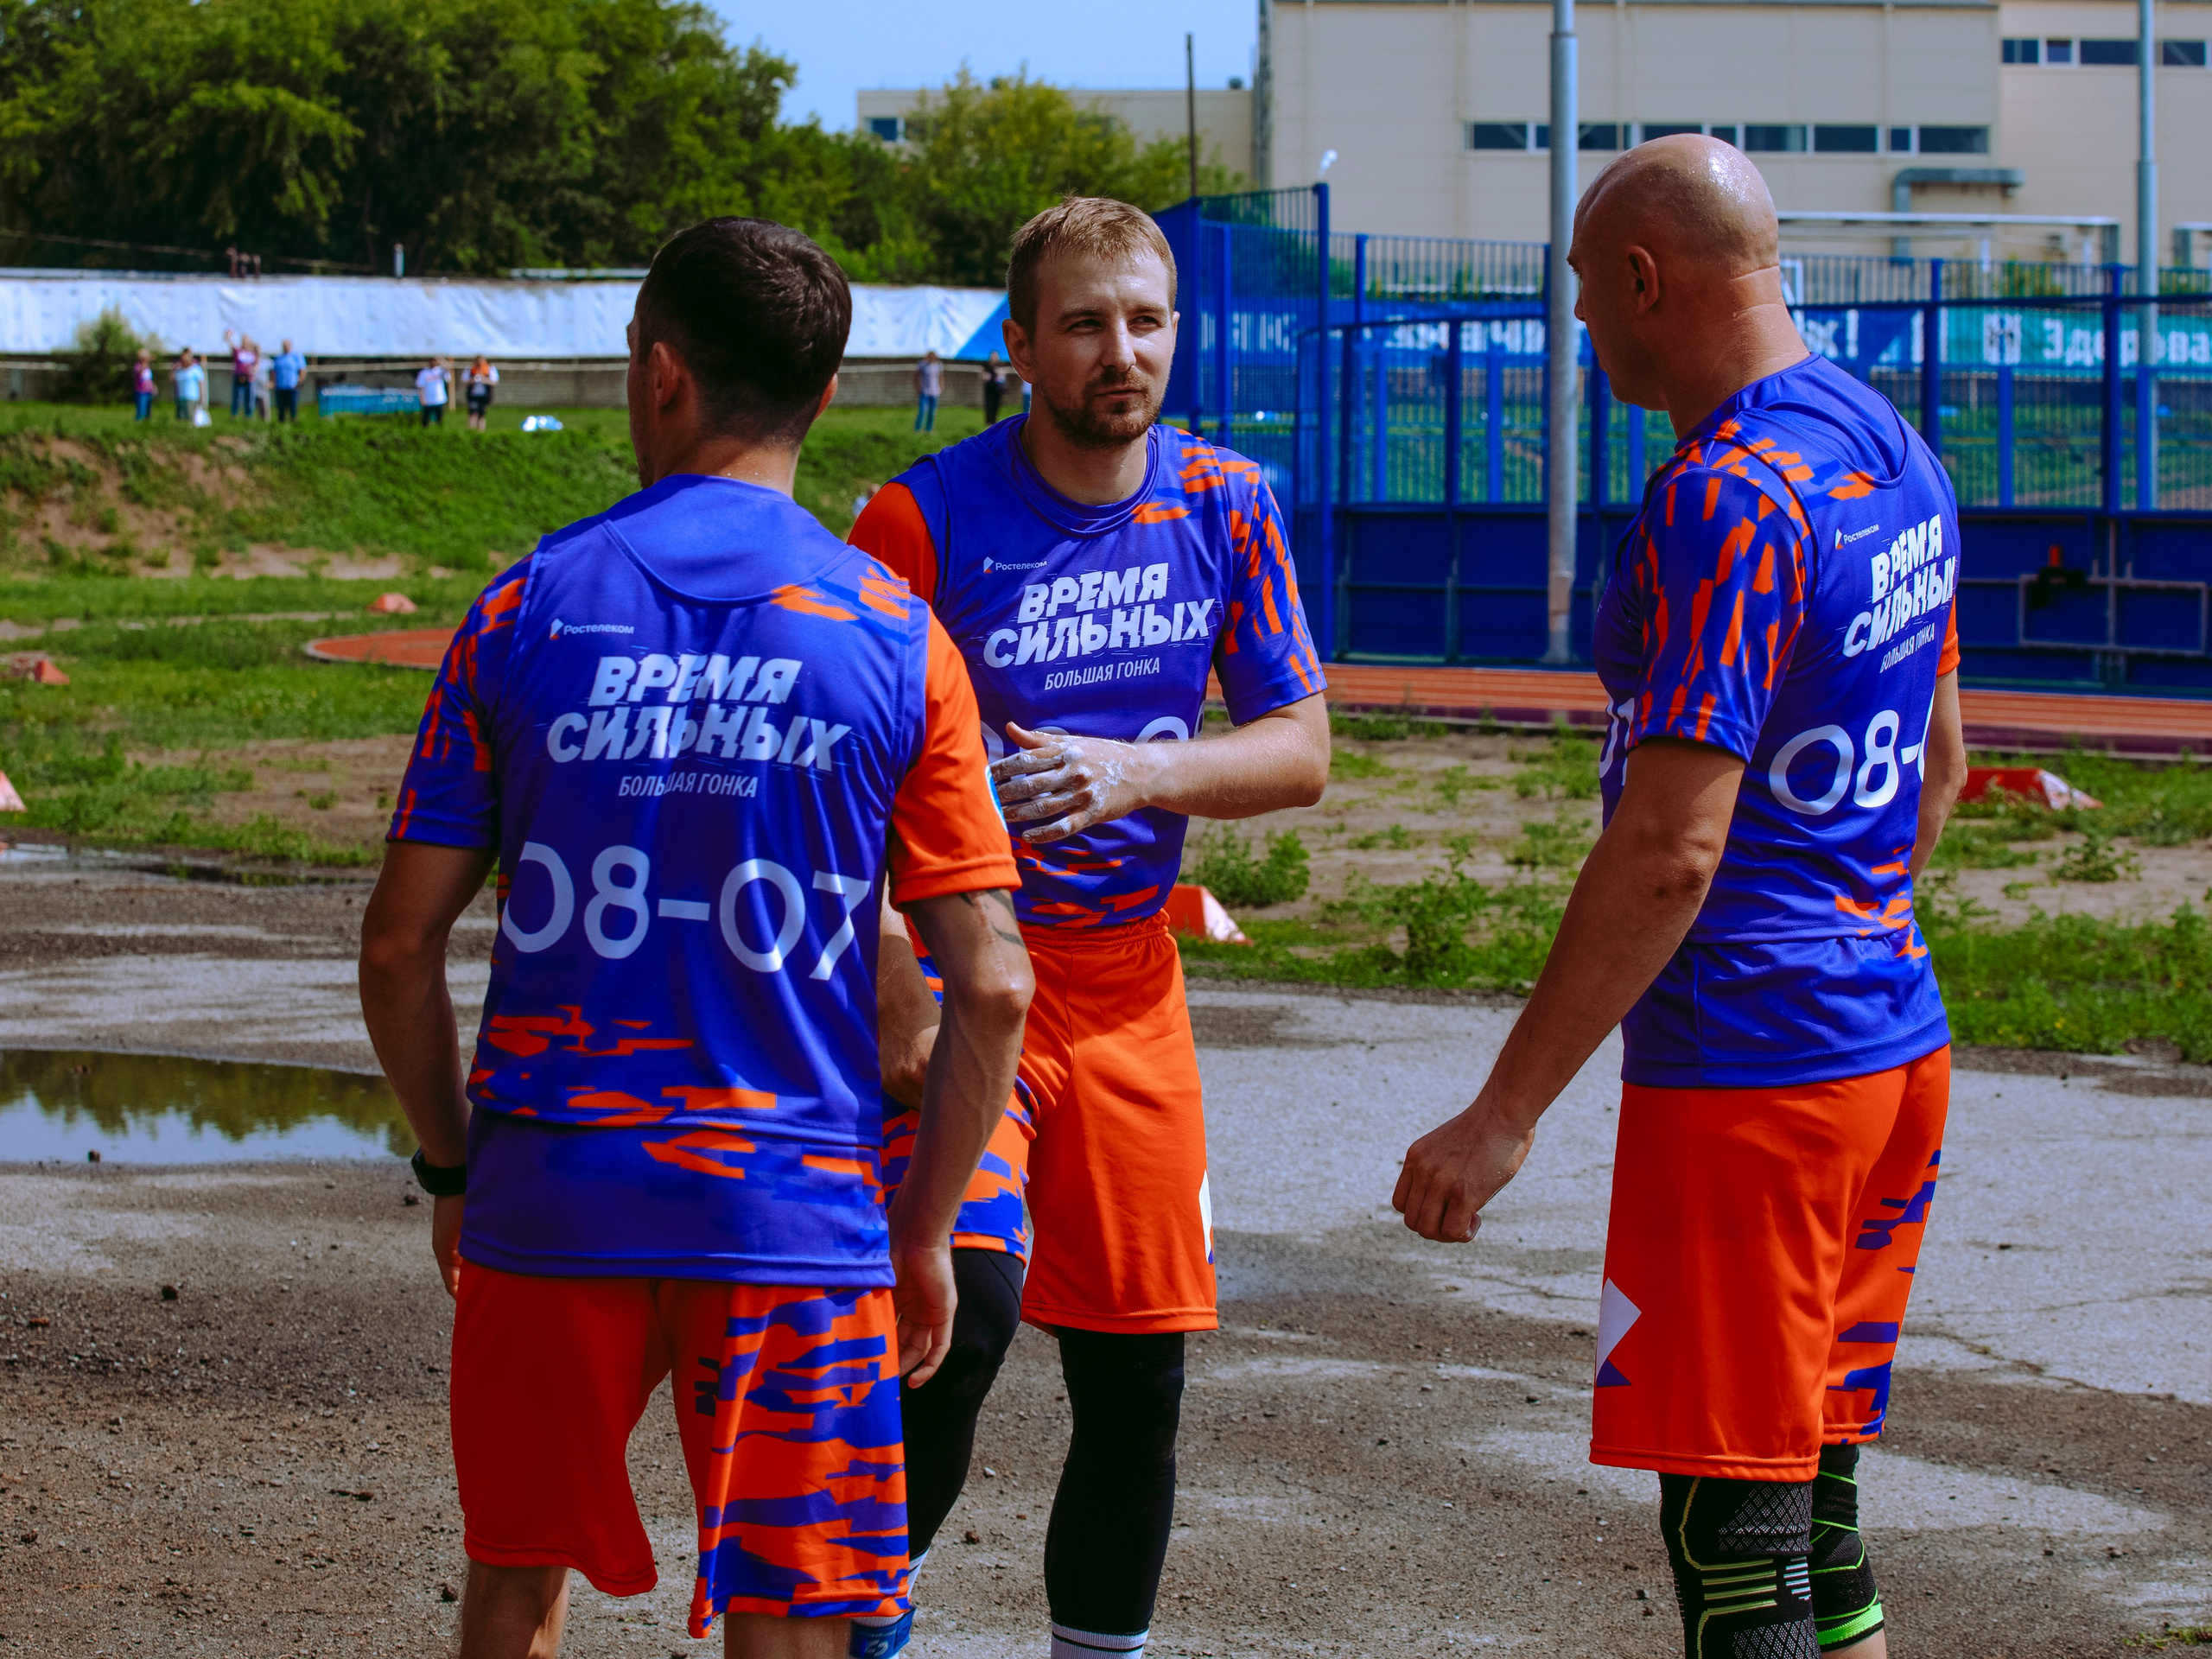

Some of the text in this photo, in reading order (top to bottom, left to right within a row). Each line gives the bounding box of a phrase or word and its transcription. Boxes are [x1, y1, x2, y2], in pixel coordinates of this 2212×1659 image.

[1843, 524, 1879, 544] Ростелеком
[1871, 513, 1942, 604] ВРЕМЯ
[995, 561, 1047, 571] Ростелеком
[1017, 563, 1169, 623] ВРЕМЯ
[563, 624, 635, 635] Ростелеком
[983, 599, 1216, 668] СИЛЬНЫХ
[1879, 635, 1916, 673] БОЛЬШАЯ
[588, 653, 804, 707] ВРЕМЯ
[1044, 657, 1160, 690] БОЛЬШАЯ ГОНКА
[547, 704, 853, 772] СИЛЬНЫХ
[1769, 686, 1935, 816] 08-
[697, 773, 759, 798] ГОНКА
[502, 842, 871, 981] 08-07
